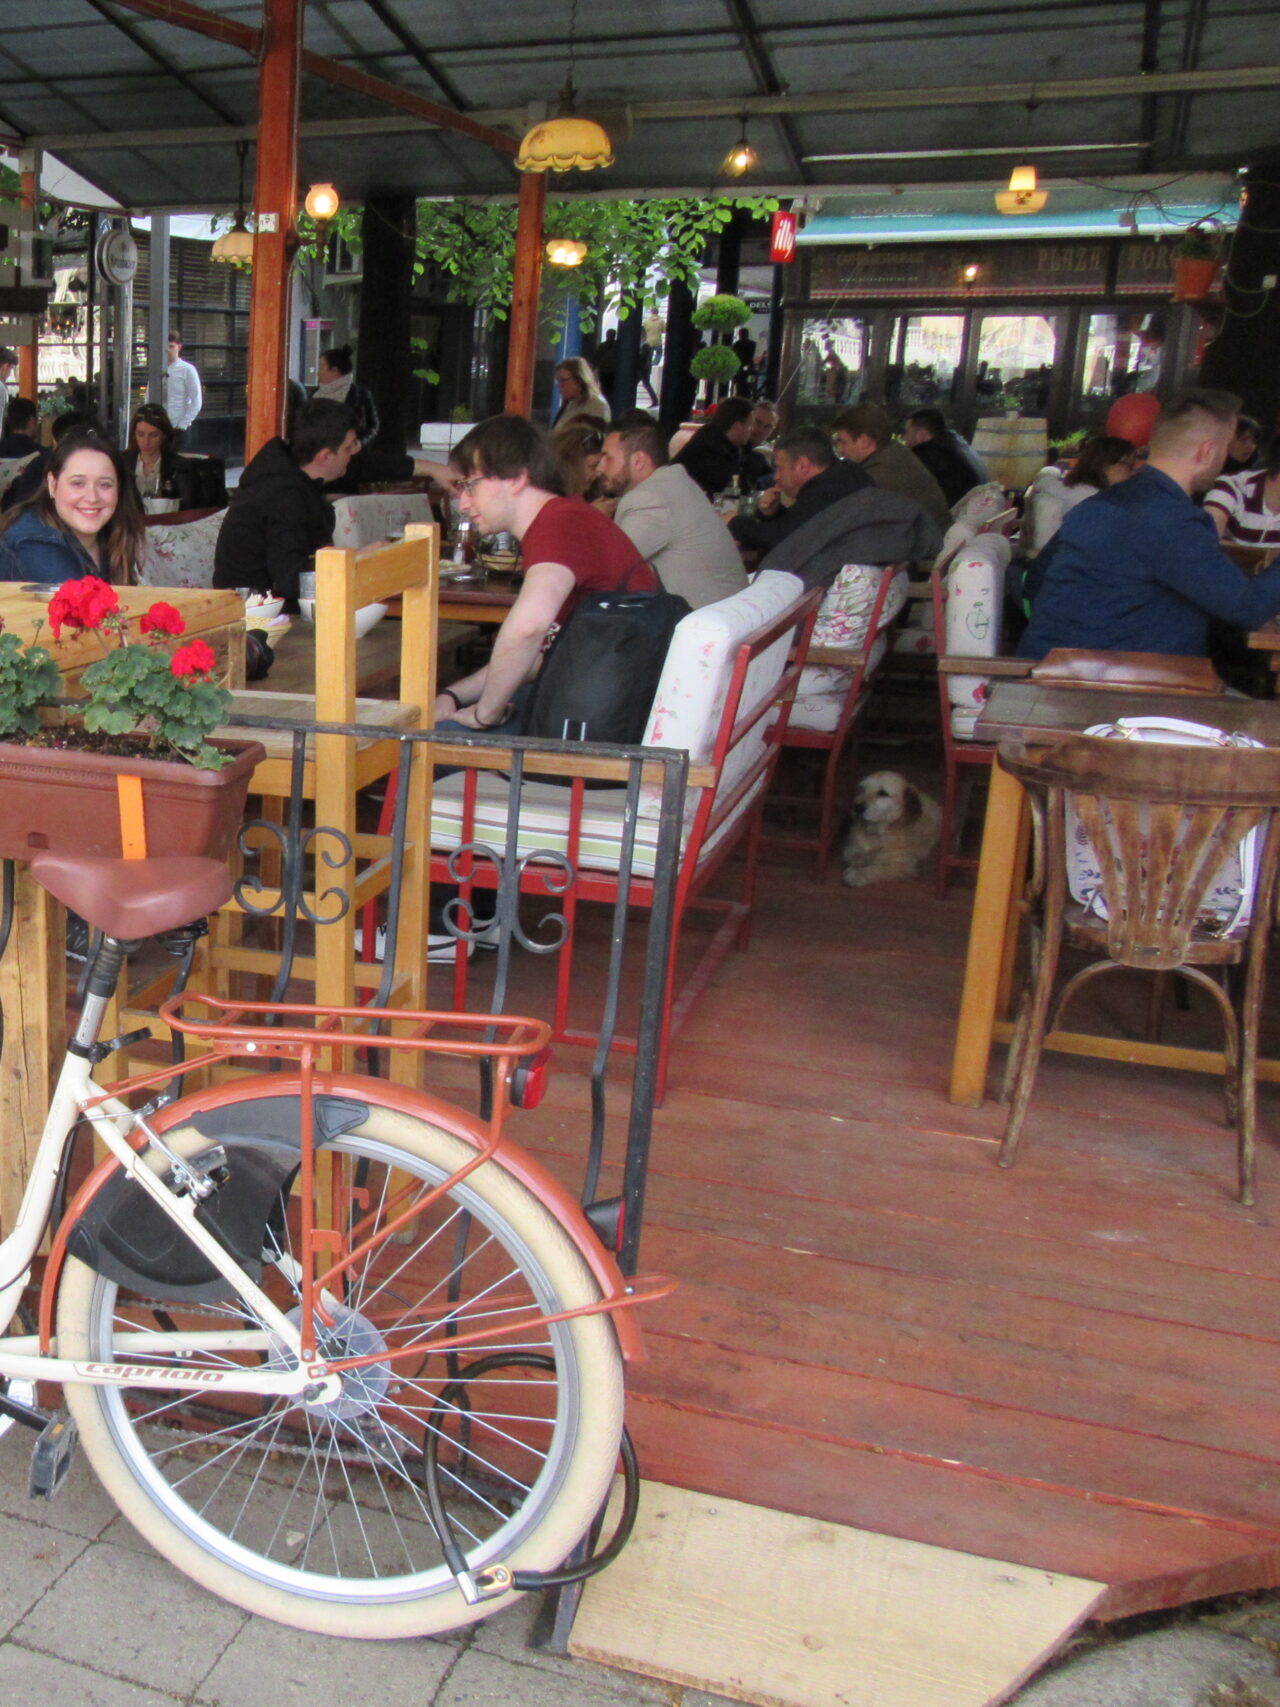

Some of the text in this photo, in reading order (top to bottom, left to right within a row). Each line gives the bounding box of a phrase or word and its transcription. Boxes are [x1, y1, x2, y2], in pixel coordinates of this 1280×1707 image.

[774, 219, 794, 259] illy
[1037, 247, 1101, 272] PLAZA
[85, 1363, 224, 1382] capriolo
